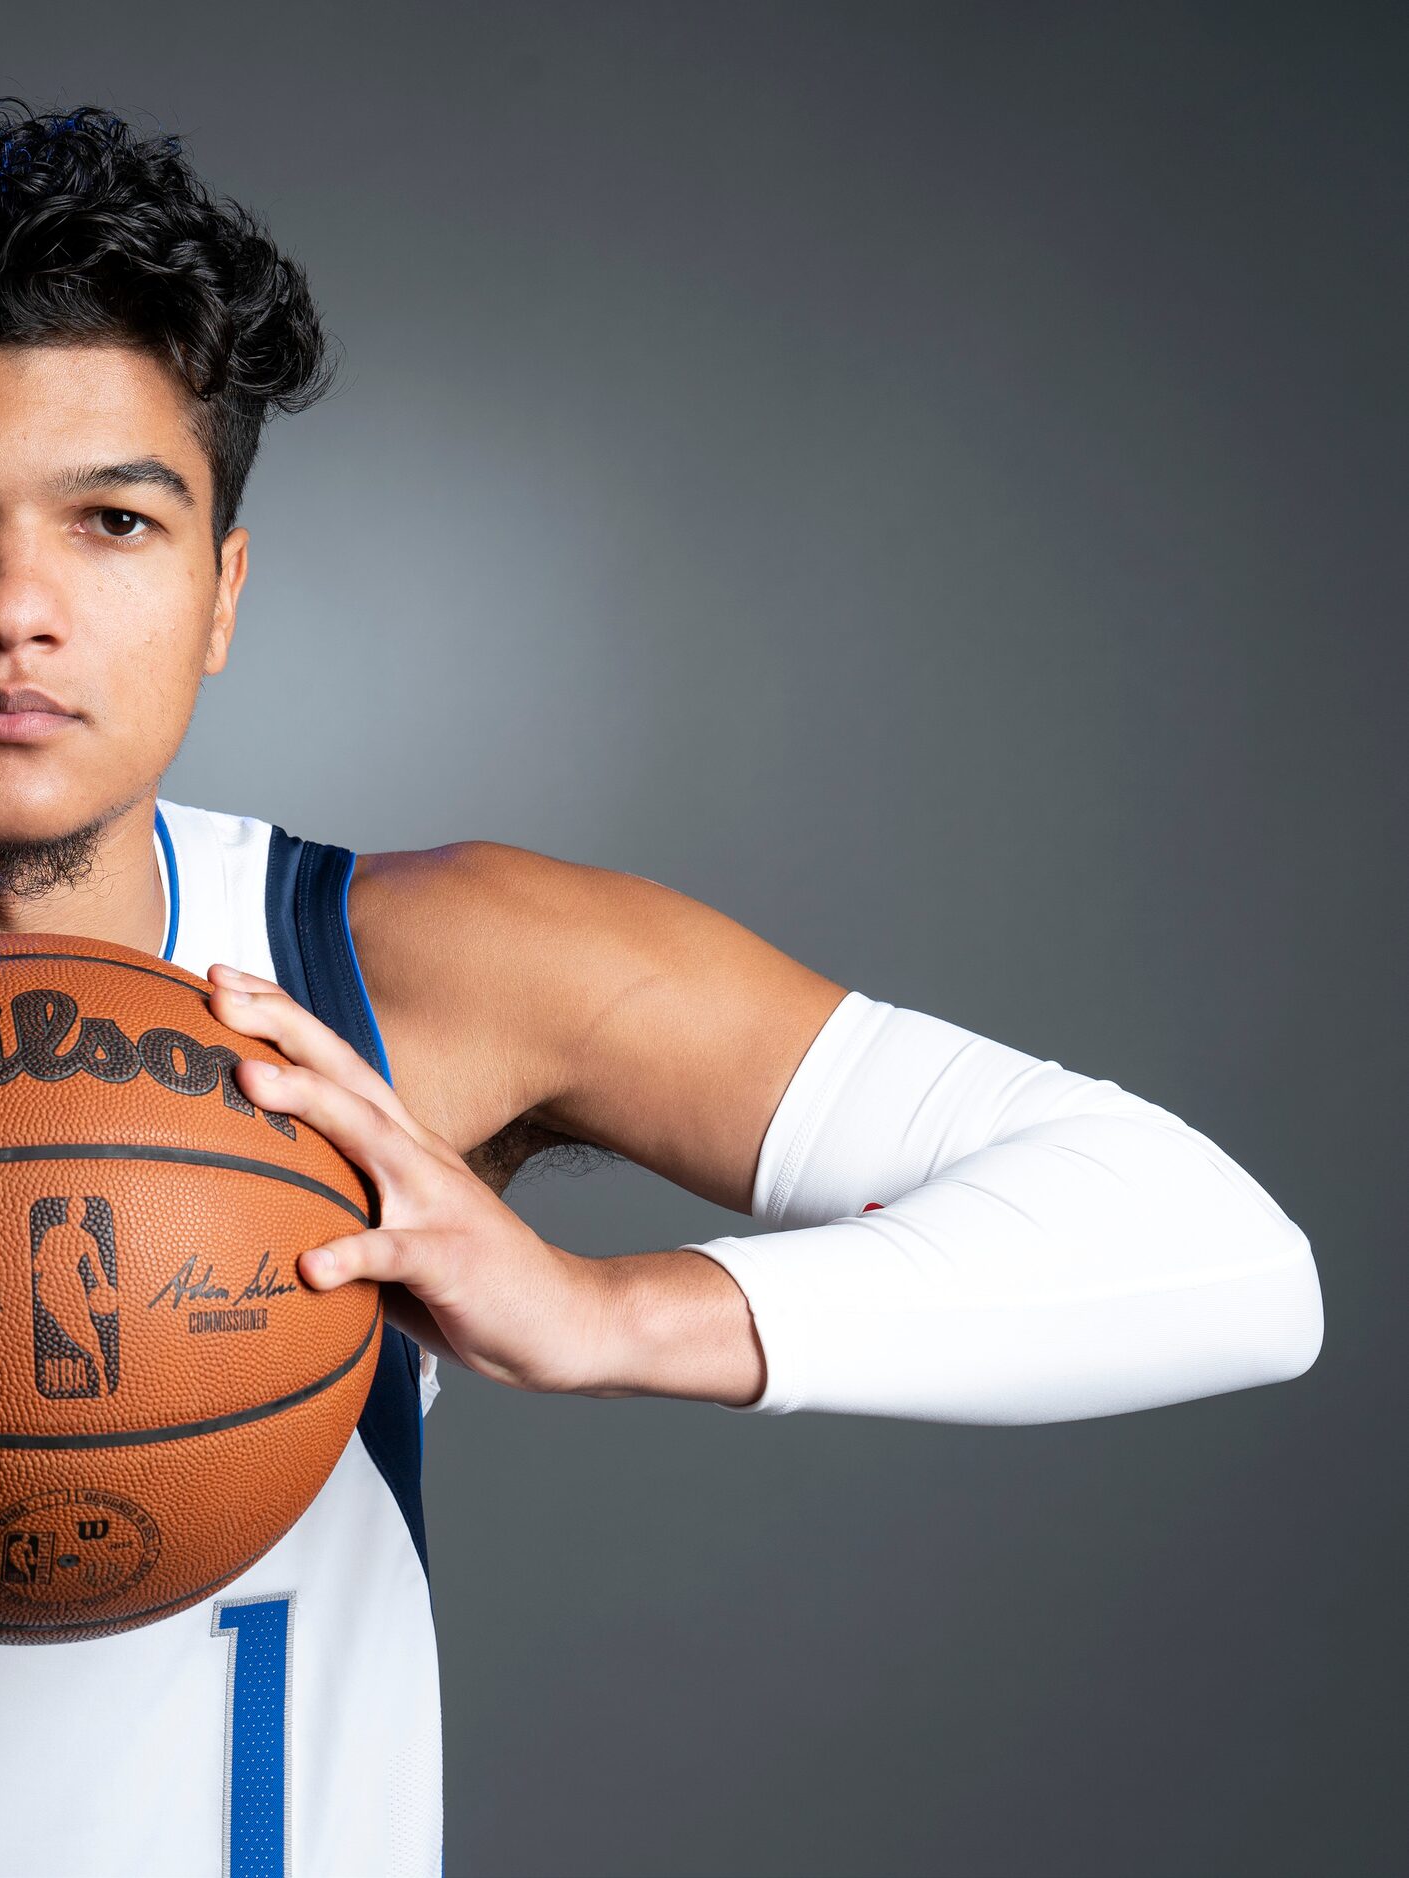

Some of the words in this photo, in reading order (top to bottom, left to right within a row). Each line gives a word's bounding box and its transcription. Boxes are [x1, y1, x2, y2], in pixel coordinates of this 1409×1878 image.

[189, 1308, 268, 1333] COMMISSIONER
[45, 1358, 89, 1391] NBA
[85, 1491, 138, 1517] DESIGNED
[209, 1590, 298, 1878] 1
